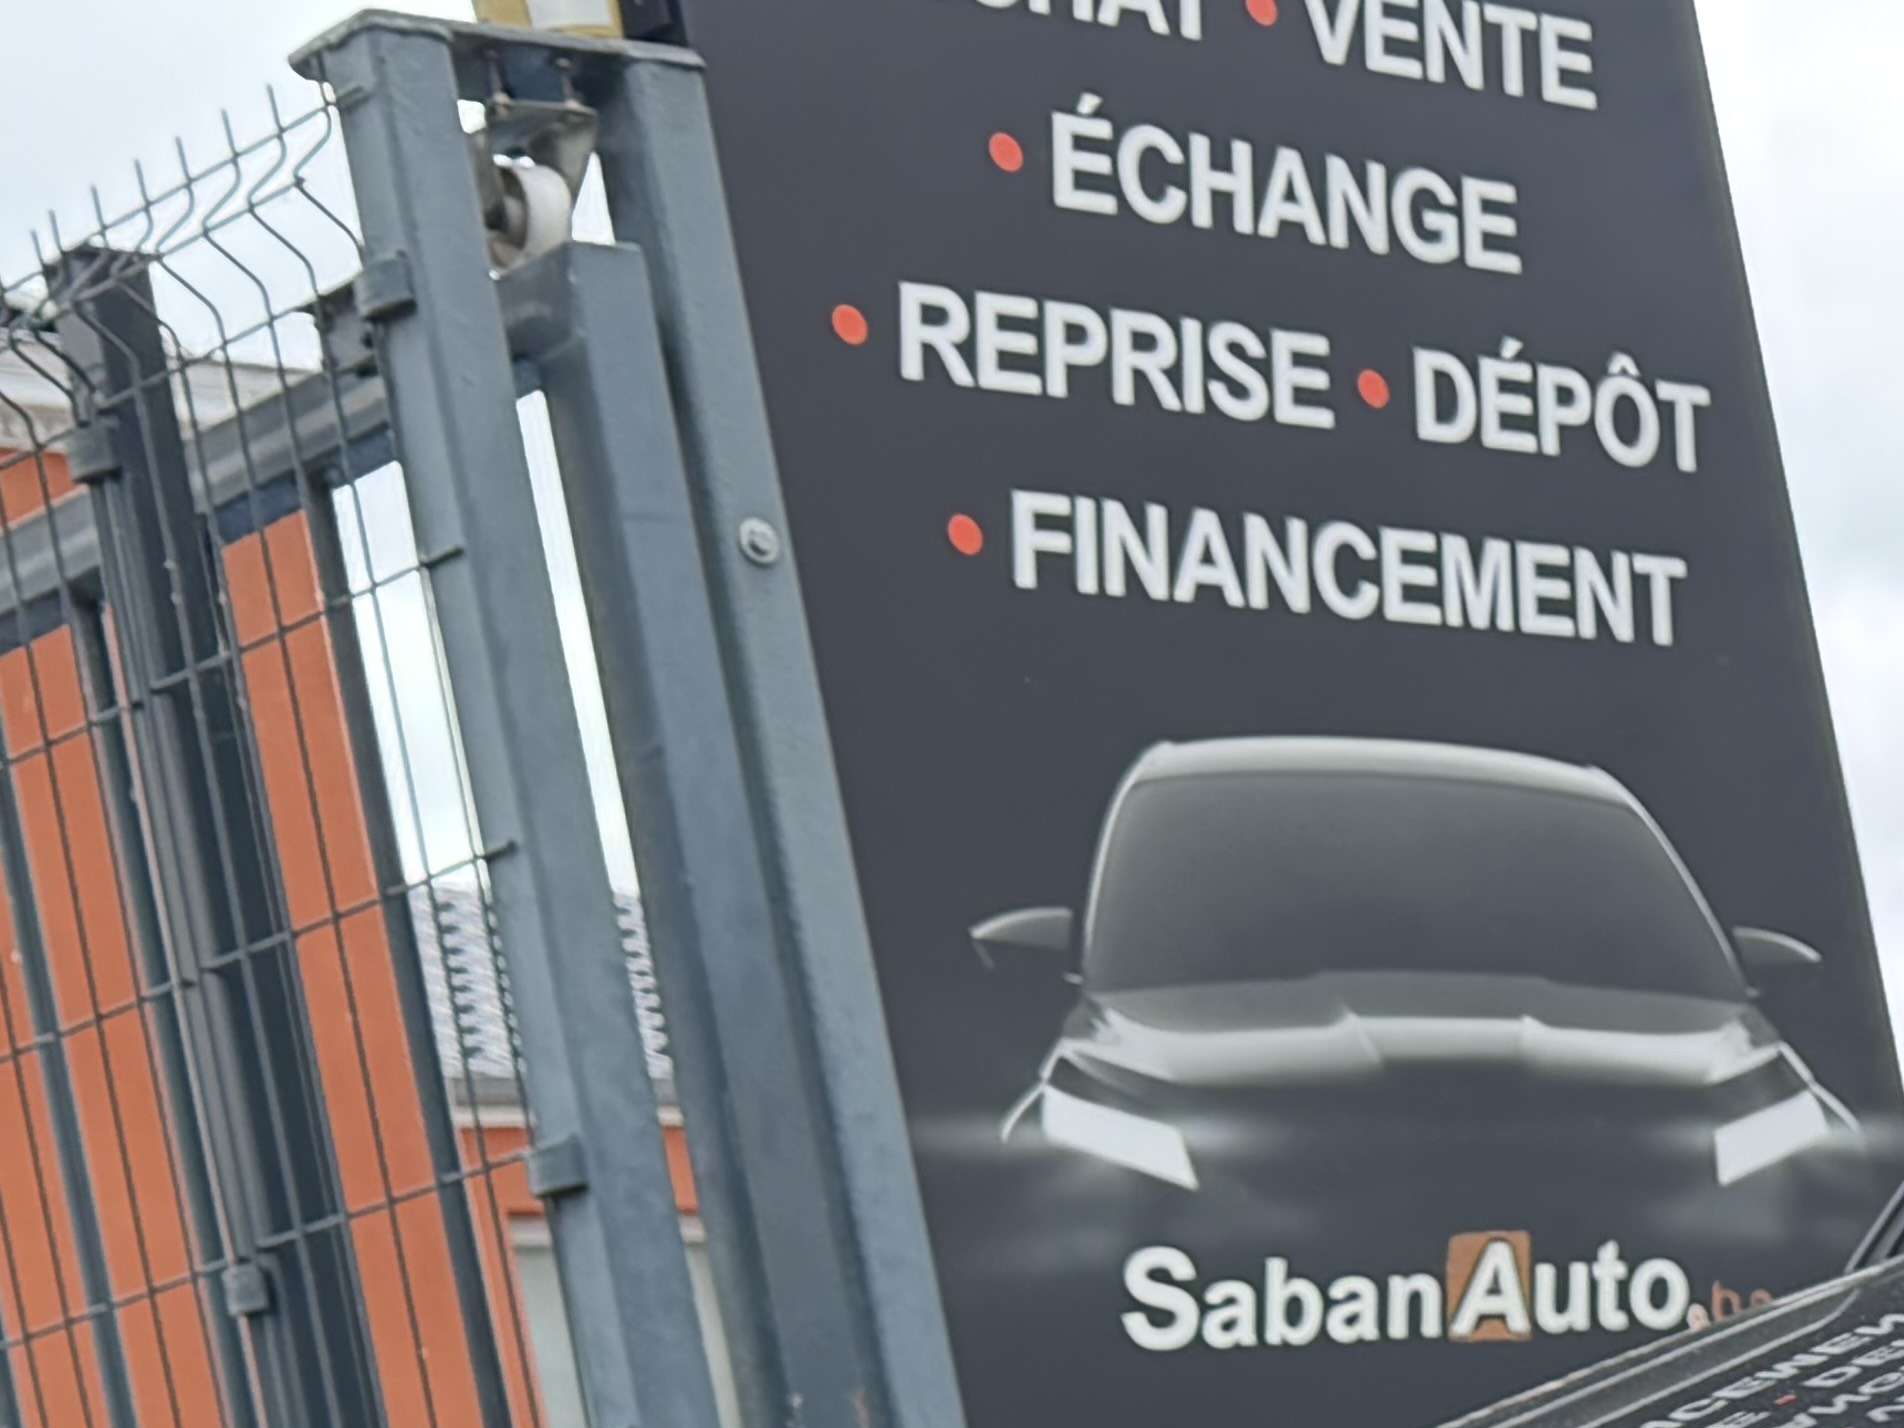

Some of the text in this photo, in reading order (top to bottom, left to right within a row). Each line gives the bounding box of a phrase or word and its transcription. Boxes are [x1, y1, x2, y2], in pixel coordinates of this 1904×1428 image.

[1308, 0, 1597, 110] VENTE
[1050, 92, 1523, 275] ÉCHANGE
[897, 281, 1711, 472] REPRISE DÉPÔT
[1009, 488, 1688, 648] FINANCEMENT
